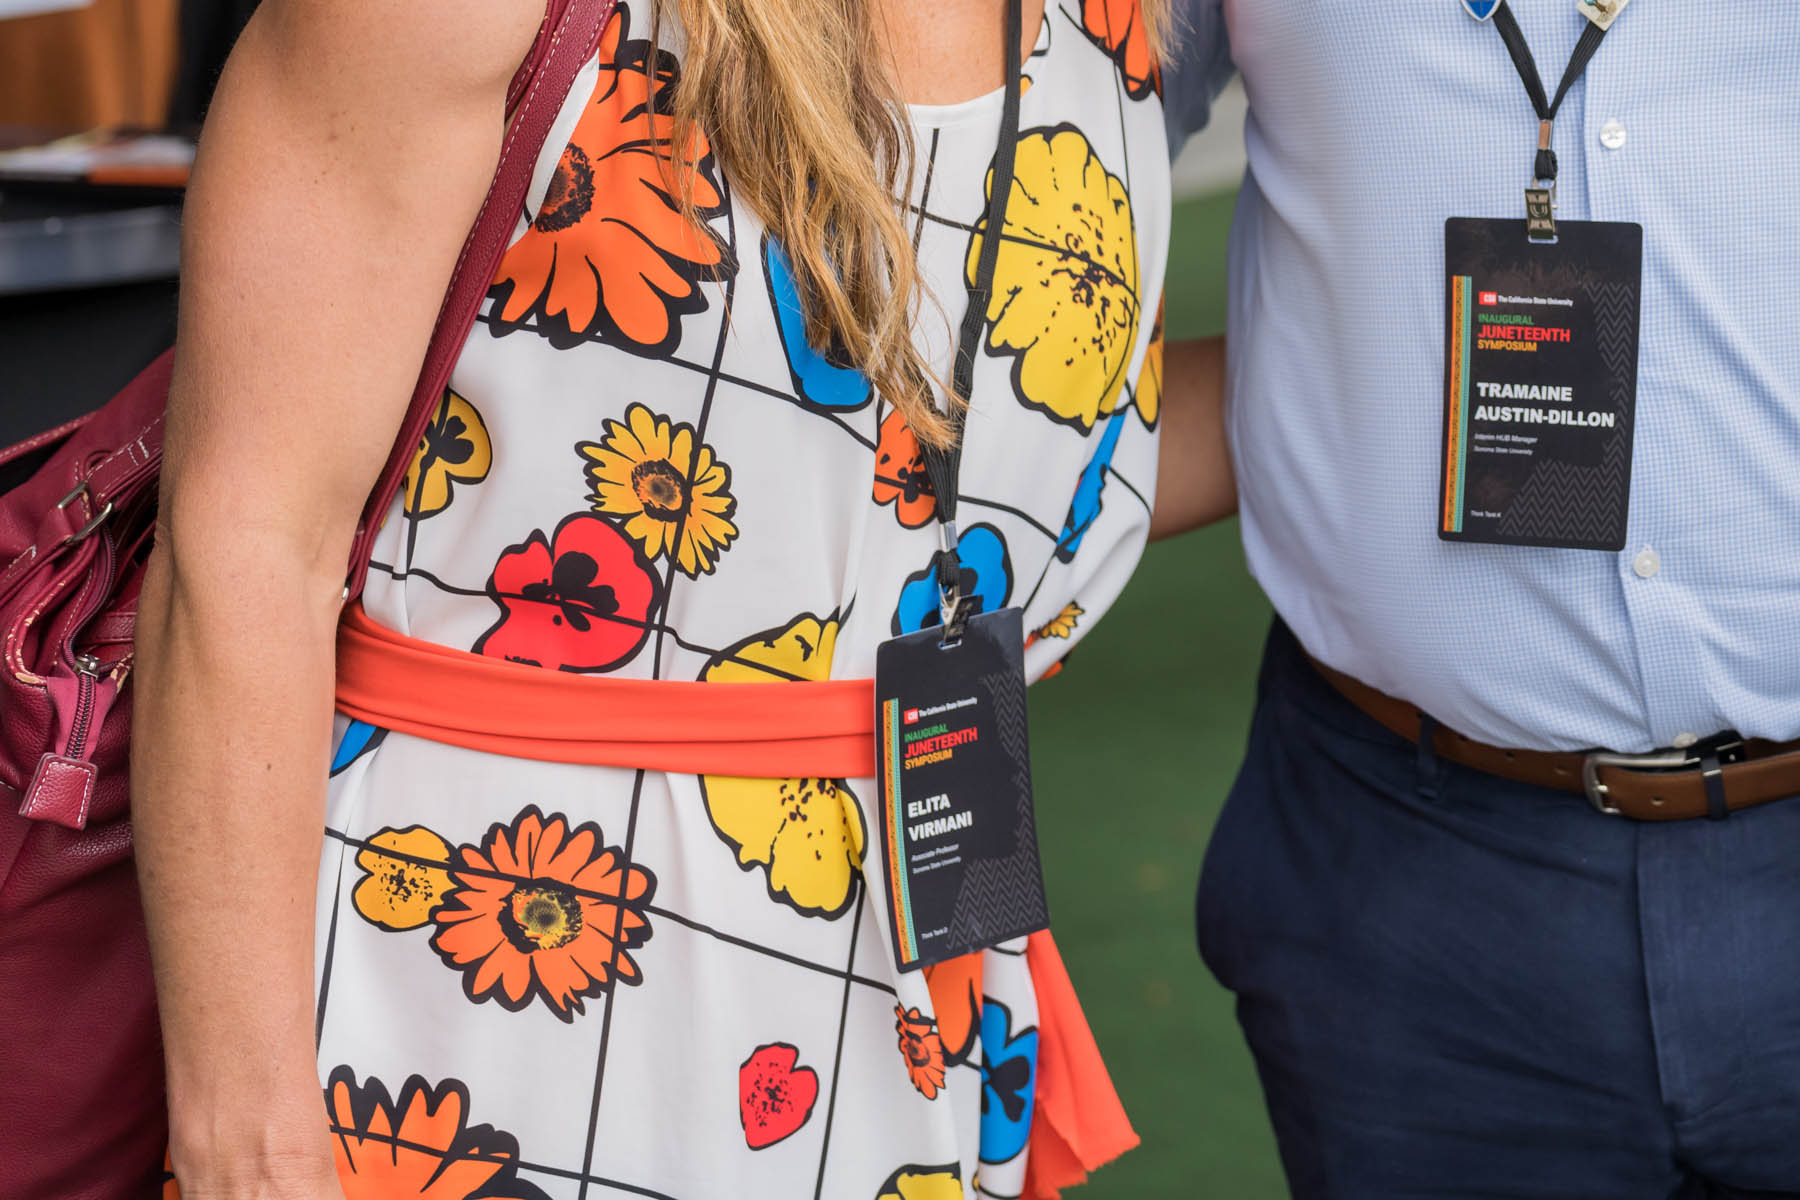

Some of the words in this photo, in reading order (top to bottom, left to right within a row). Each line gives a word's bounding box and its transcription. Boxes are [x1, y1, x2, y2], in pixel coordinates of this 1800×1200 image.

[1508, 295, 1533, 304] California
[1548, 298, 1574, 307] University
[1478, 313, 1534, 325] INAUGURAL
[1478, 325, 1571, 342] JUNETEENTH
[1478, 339, 1537, 352] SYMPOSIUM
[1477, 382, 1573, 401] TRAMAINE
[1474, 405, 1615, 427] AUSTIN-DILLON
[904, 724, 949, 743] INAUGURAL
[904, 726, 978, 759] JUNETEENTH
[905, 748, 952, 770] SYMPOSIUM
[907, 793, 951, 818] ELITA
[908, 811, 973, 842] VIRMANI
